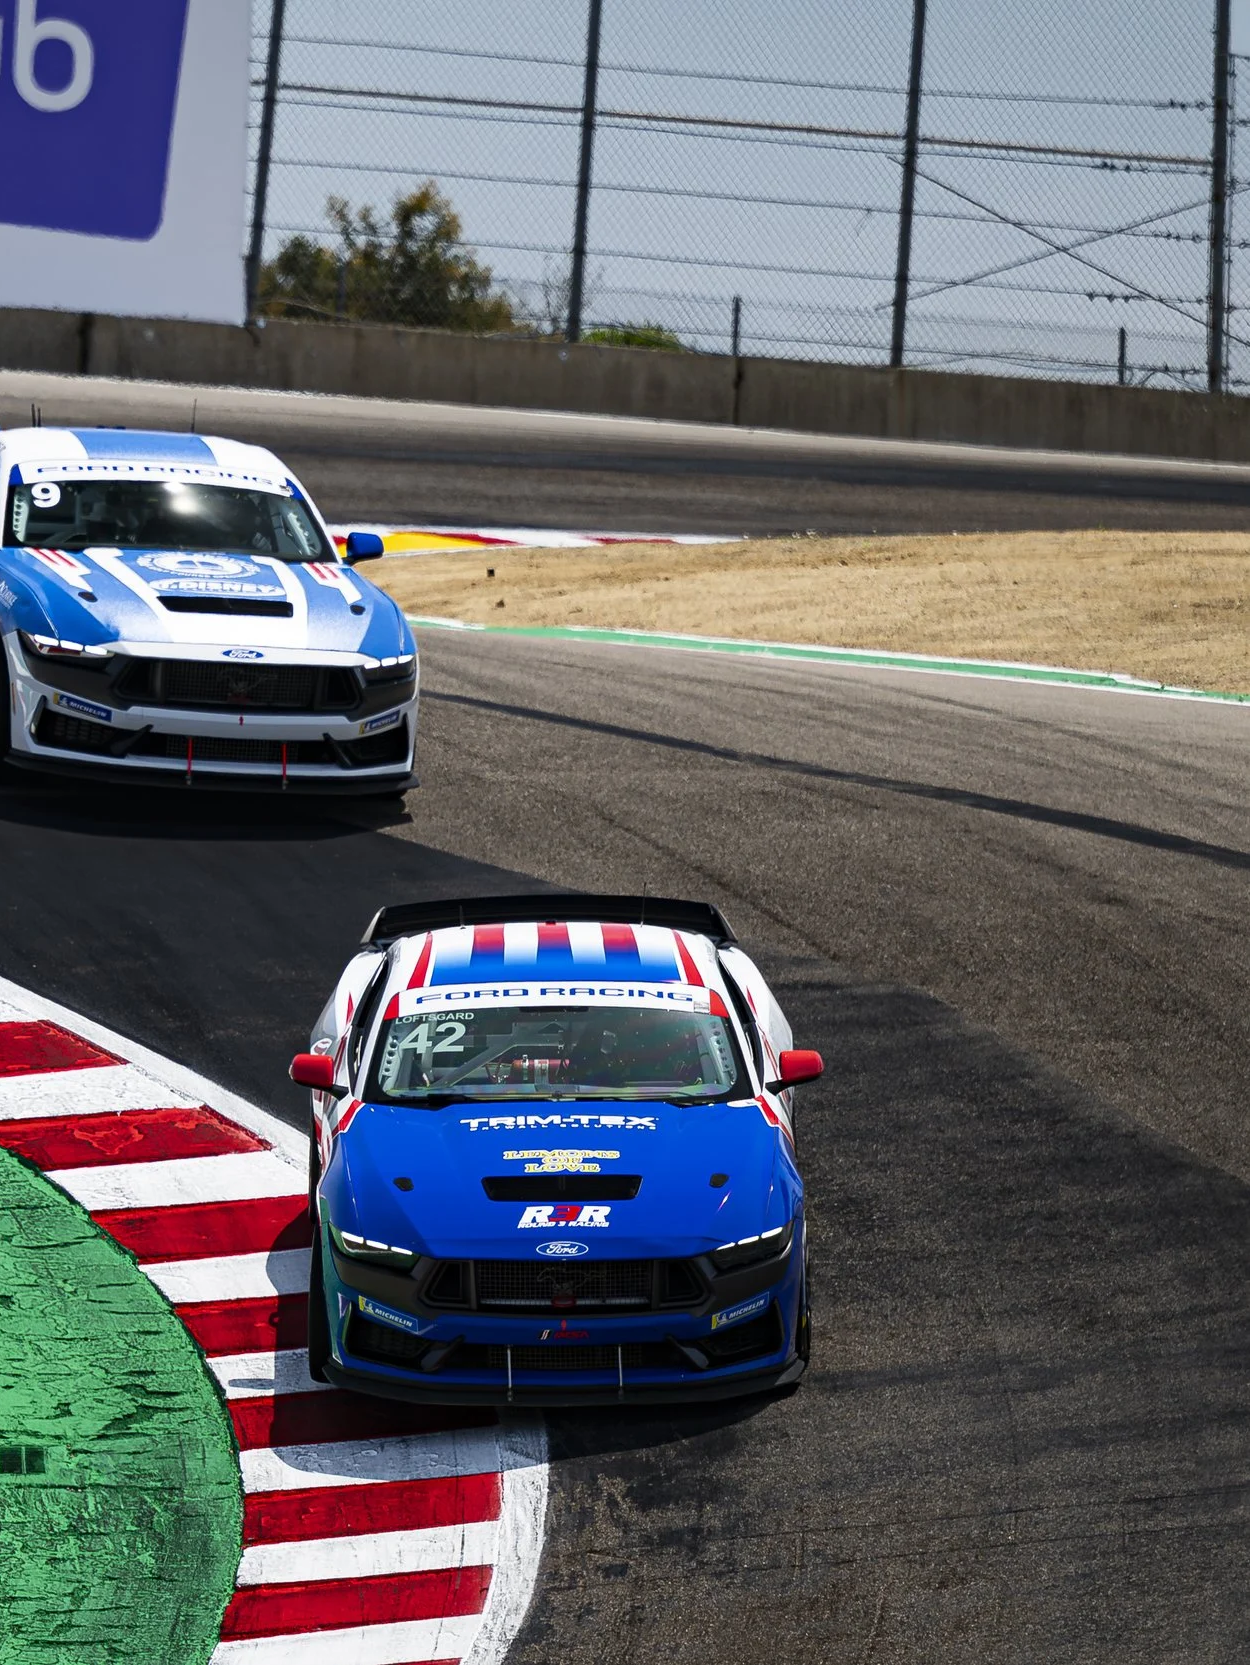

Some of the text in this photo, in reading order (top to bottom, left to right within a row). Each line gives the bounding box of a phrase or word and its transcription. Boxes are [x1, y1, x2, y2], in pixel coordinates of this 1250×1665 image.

[31, 482, 61, 508] 9
[227, 649, 258, 659] Ford
[69, 701, 108, 718] MICHELIN
[416, 987, 693, 1004] FORD RACING
[395, 1012, 475, 1024] LOFTSGARD
[399, 1021, 466, 1054] 42
[459, 1115, 657, 1128] TRIM-TEX
[503, 1150, 620, 1159] LEMONS
[542, 1156, 583, 1164] OF
[524, 1163, 601, 1173] LOVE
[517, 1221, 556, 1229] ROUND
[546, 1243, 579, 1254] Ford
[729, 1299, 765, 1319] MICHELIN
[375, 1308, 413, 1327] MICHELIN
